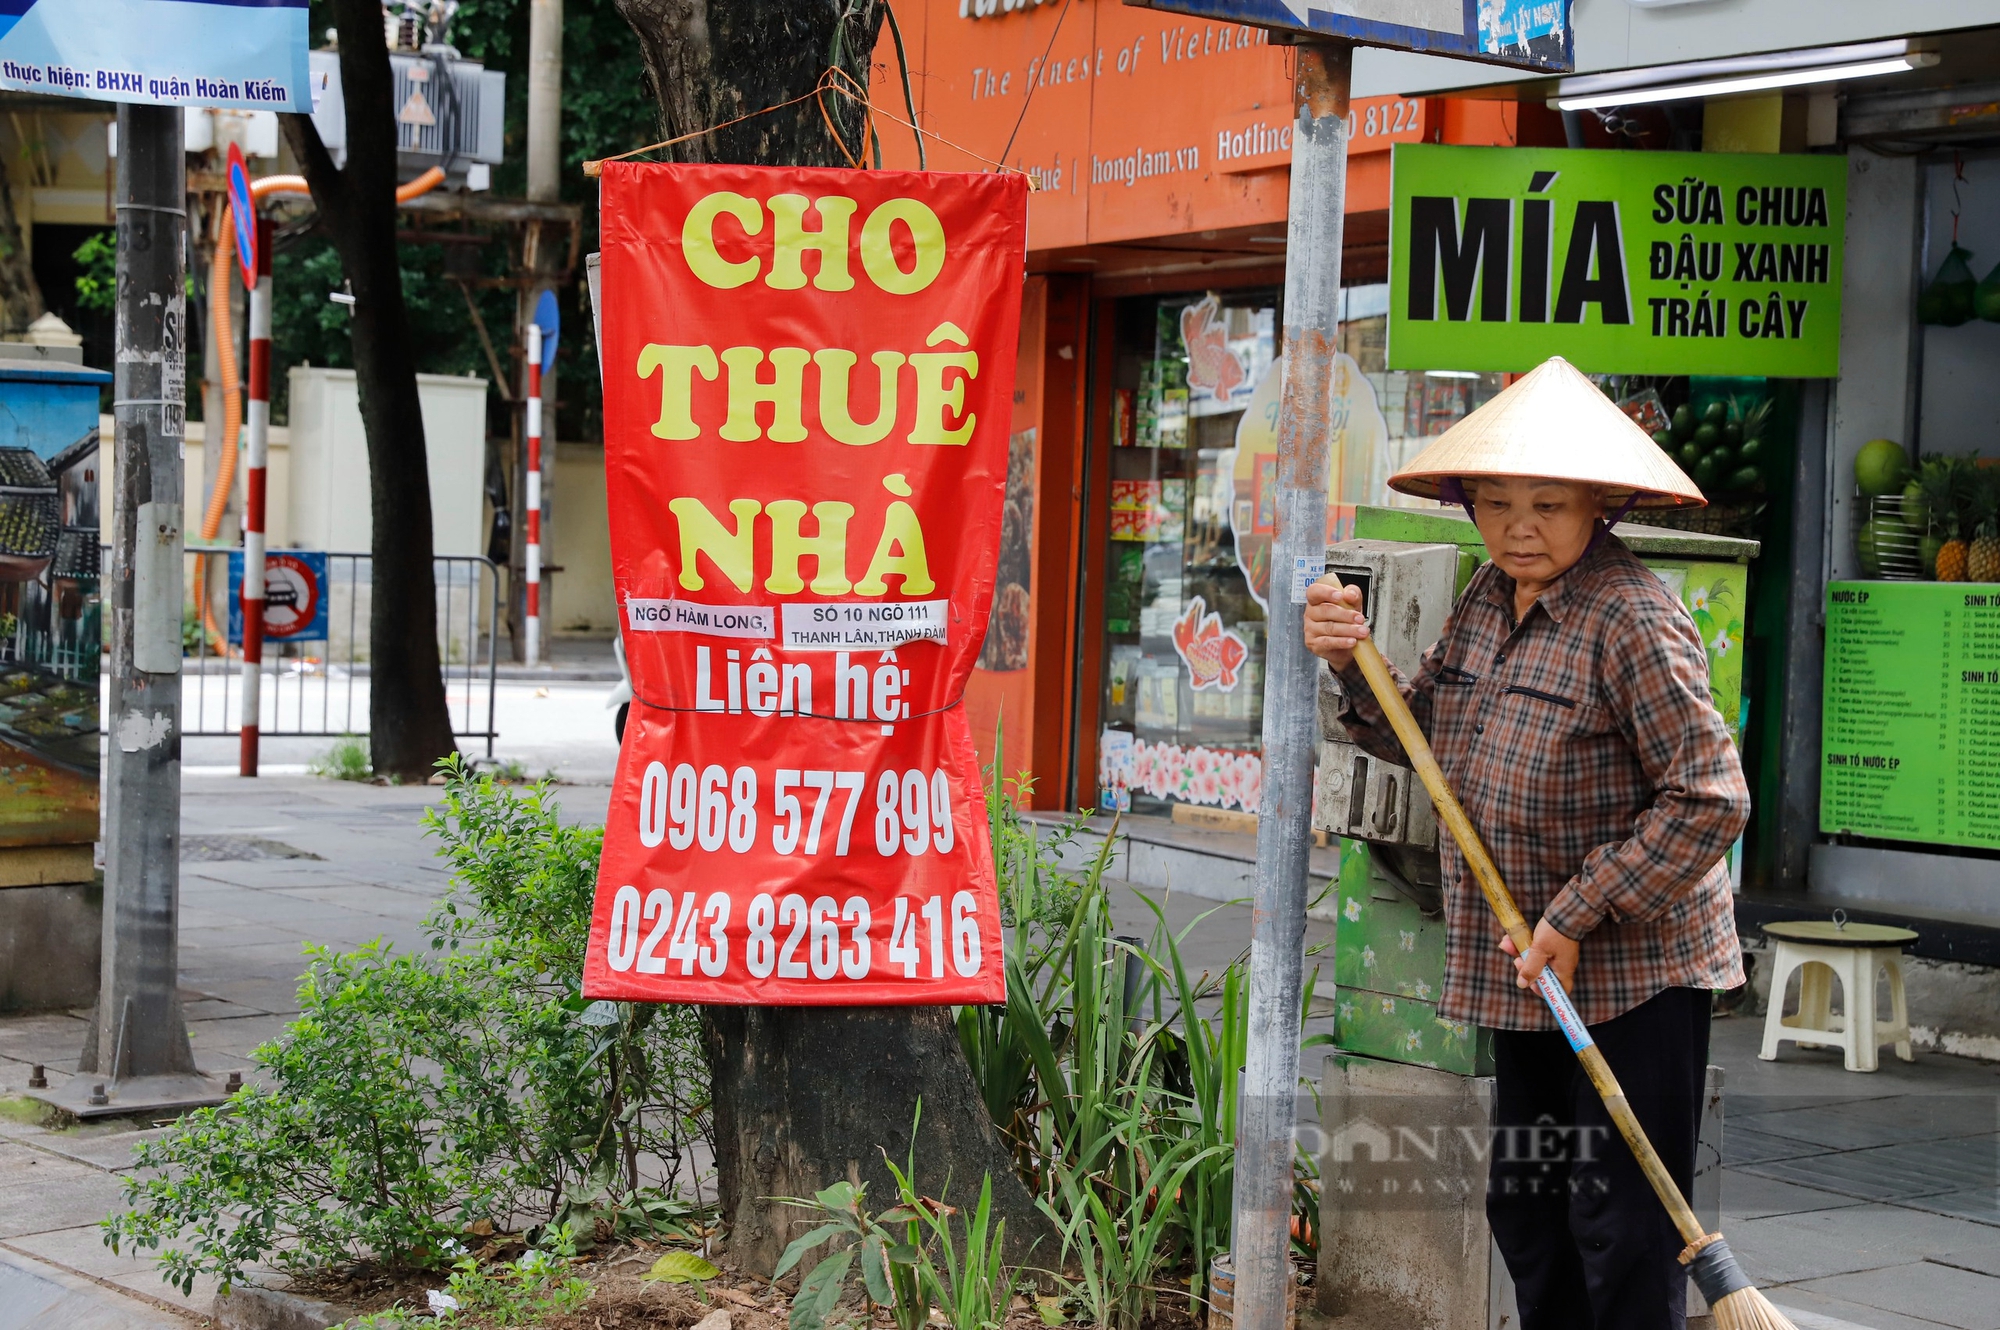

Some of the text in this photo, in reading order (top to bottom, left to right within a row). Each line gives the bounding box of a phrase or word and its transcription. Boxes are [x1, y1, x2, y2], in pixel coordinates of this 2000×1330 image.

[3, 61, 286, 101] thực hiện: BHXH quận Hoàn Kiếm
[972, 67, 1011, 100] The
[1024, 49, 1104, 96] finest
[1117, 35, 1145, 77] of
[1217, 121, 1292, 161] Hotline
[1364, 99, 1419, 138] 8122
[1092, 146, 1199, 187] honglam.vn
[1652, 177, 1828, 228] SỮA CHUA
[682, 191, 945, 295] CHO
[1408, 171, 1634, 325] MÍA
[1649, 233, 1829, 290] ĐẬU XANH
[1648, 290, 1808, 339] TRÁI CÂY
[636, 321, 978, 447] THUÊ
[669, 474, 936, 597] NHÀ
[635, 606, 768, 633] NGÕ HÀM LONG,
[813, 604, 929, 623] SỐ 10 NGÕ 111
[1832, 589, 1869, 603] NƯỚC ÉP
[1964, 594, 1987, 606] SINH
[792, 631, 840, 644] THANH
[924, 625, 946, 640] ĐÀM
[695, 645, 910, 737] Liên hệ:
[1962, 668, 1998, 683] SINH TỐ
[1827, 752, 1900, 769] SINH TỐ NƯỚC ÉP
[640, 761, 955, 857] 0968 577 899
[607, 885, 982, 980] 0243 8263 416
